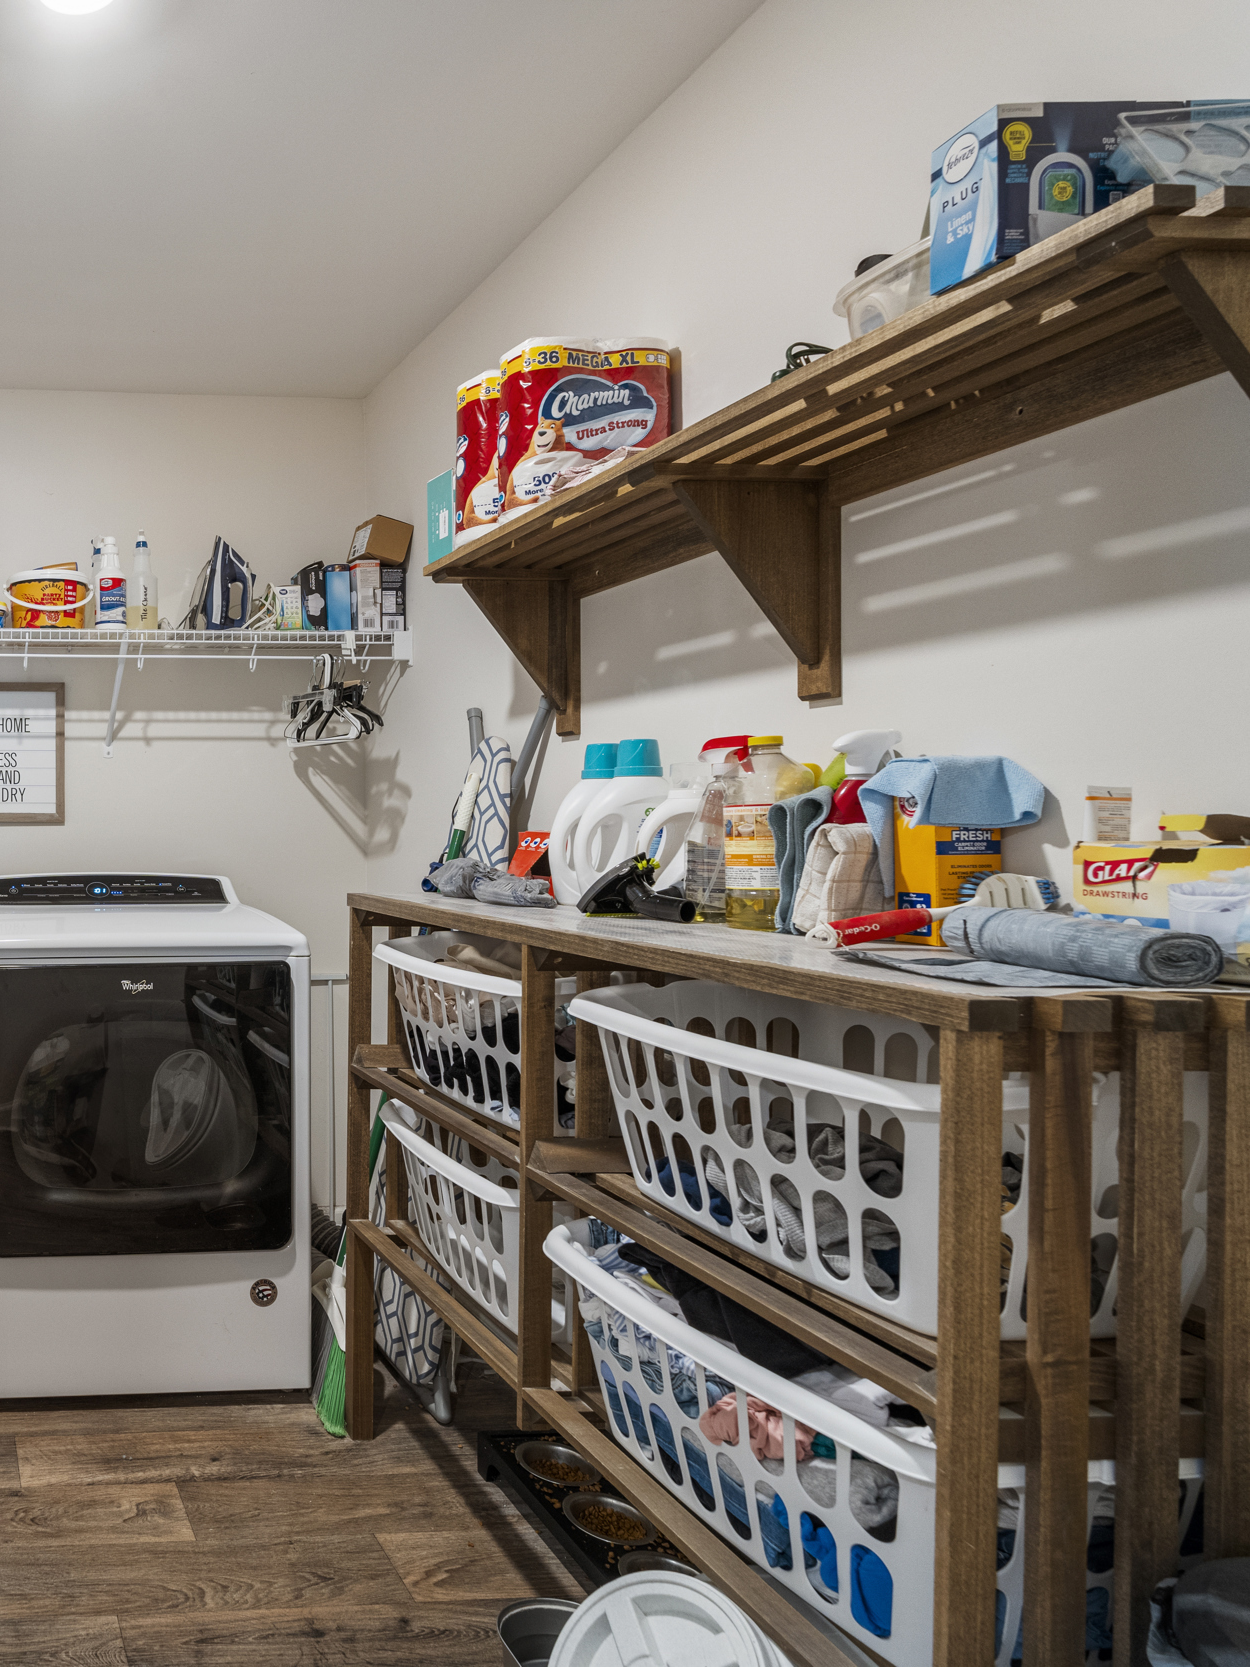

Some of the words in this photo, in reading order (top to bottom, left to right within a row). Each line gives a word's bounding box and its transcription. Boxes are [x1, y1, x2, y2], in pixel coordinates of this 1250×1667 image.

[945, 145, 976, 175] febreze
[947, 211, 972, 232] Linen
[946, 232, 955, 244] &
[956, 221, 974, 238] Sky
[567, 351, 613, 369] MEGA
[619, 352, 640, 367] XL
[551, 383, 631, 419] Charmin
[576, 426, 607, 440] Ultra
[607, 419, 648, 432] Strong
[524, 488, 544, 496] More
[40, 583, 64, 592] FIREBALL
[140, 609, 148, 621] Tile
[952, 830, 991, 840] FRESH
[1086, 861, 1155, 882] GLAD
[1082, 889, 1148, 900] DRAWSTRING
[844, 923, 880, 935] O-Cedar
[120, 979, 154, 995] Whirlpool
